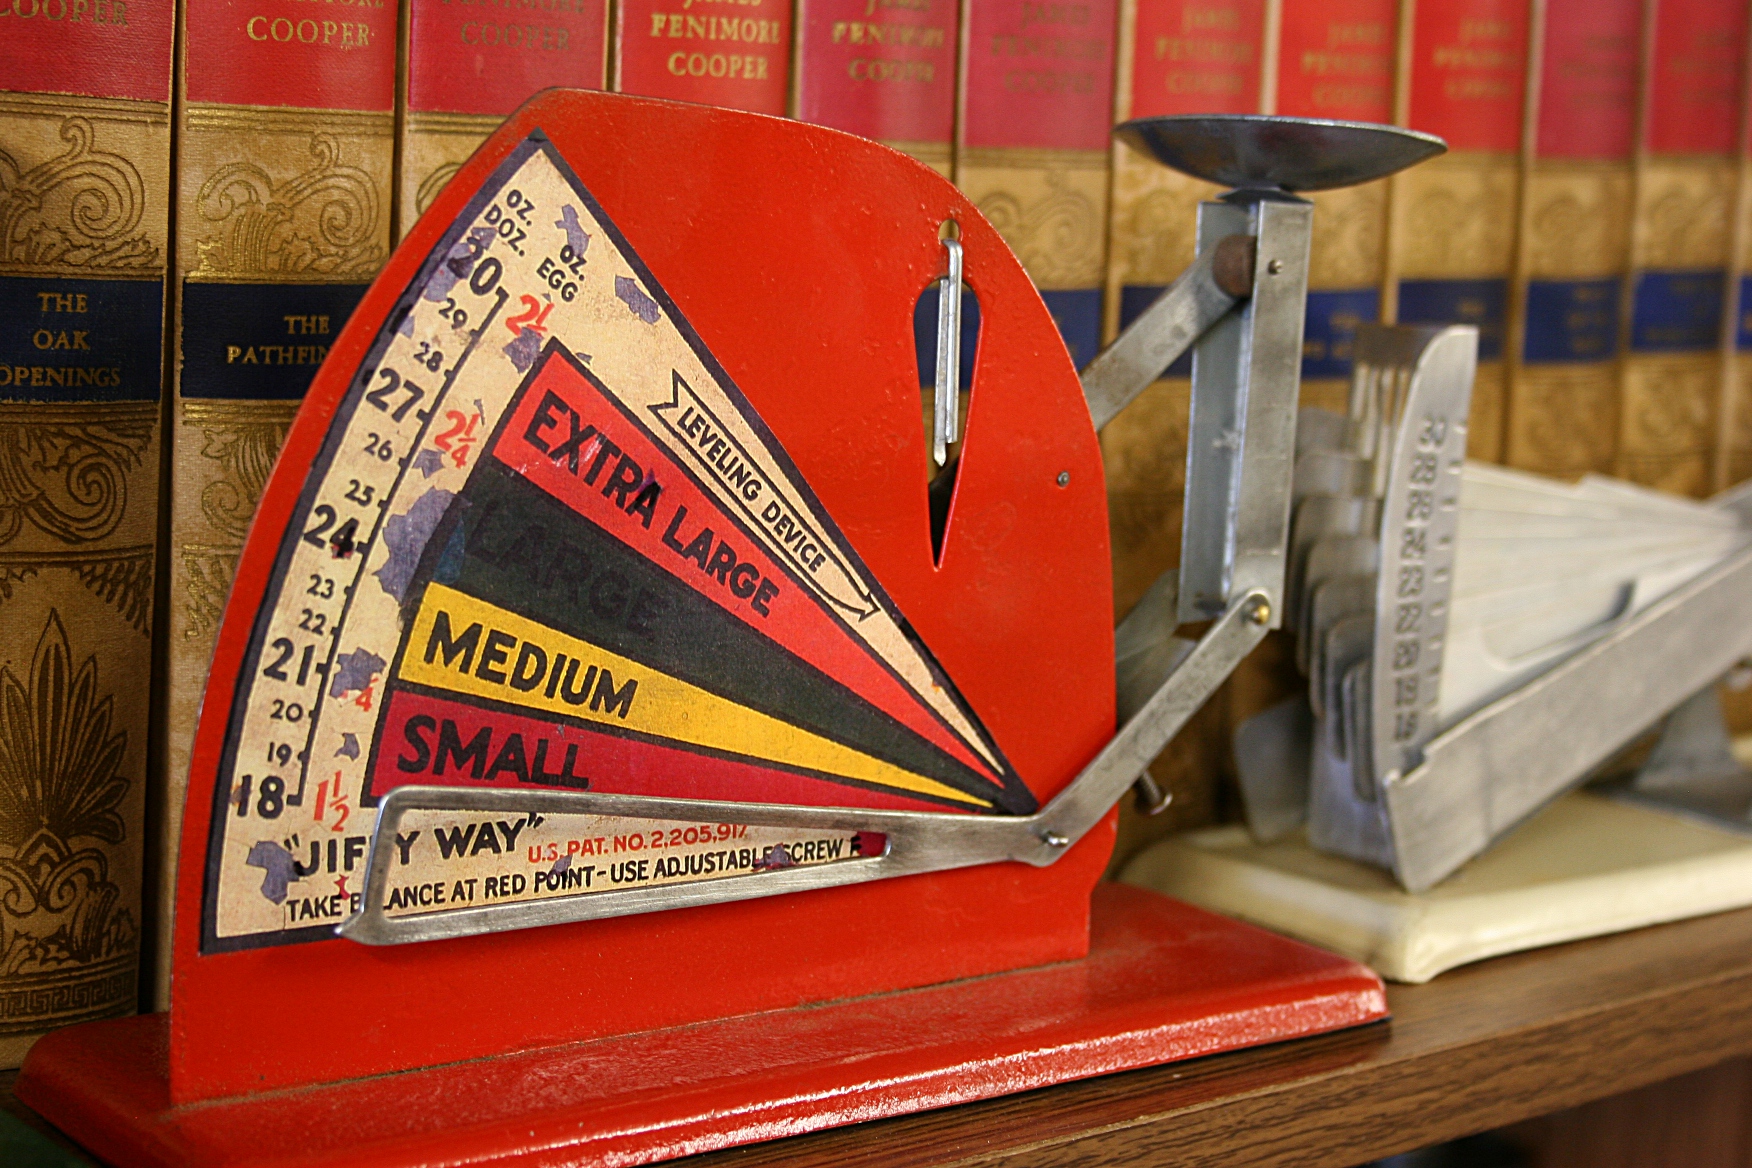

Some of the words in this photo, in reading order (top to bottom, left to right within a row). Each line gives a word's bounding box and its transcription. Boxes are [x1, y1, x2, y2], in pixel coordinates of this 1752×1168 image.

[247, 16, 370, 46] COOPER
[461, 21, 570, 50] COOPER
[667, 51, 768, 80] COOPER
[506, 189, 535, 226] OZ.
[484, 204, 526, 257] DOZ.
[560, 244, 588, 281] OZ.
[536, 257, 579, 303] EGG
[37, 292, 88, 313] THE
[438, 298, 468, 329] 29
[33, 329, 90, 351] OAK
[284, 315, 330, 335] THE
[413, 341, 444, 372] 28
[366, 368, 425, 423] 27
[364, 432, 393, 462] 26
[344, 479, 375, 507] 25
[523, 389, 662, 530] EXTRA
[661, 507, 780, 618] LARGE
[677, 406, 762, 502] LEVELING
[761, 500, 826, 573] DEVICE
[303, 504, 359, 557] 24
[465, 497, 660, 636] LARGE
[306, 574, 335, 599] 23
[299, 608, 327, 636] 22
[263, 637, 315, 687] 21
[424, 610, 639, 719] MEDIUM
[270, 699, 304, 722] 20
[267, 741, 292, 767] 19
[397, 714, 589, 789] SMALL
[237, 775, 285, 820] 18
[284, 830, 420, 877] "JIFY
[614, 832, 648, 853] NO.
[286, 895, 342, 922] TAKE
[351, 882, 446, 914] BANCE
[451, 878, 478, 902] AT
[485, 873, 526, 899] RED
[782, 837, 844, 862] SCREW
